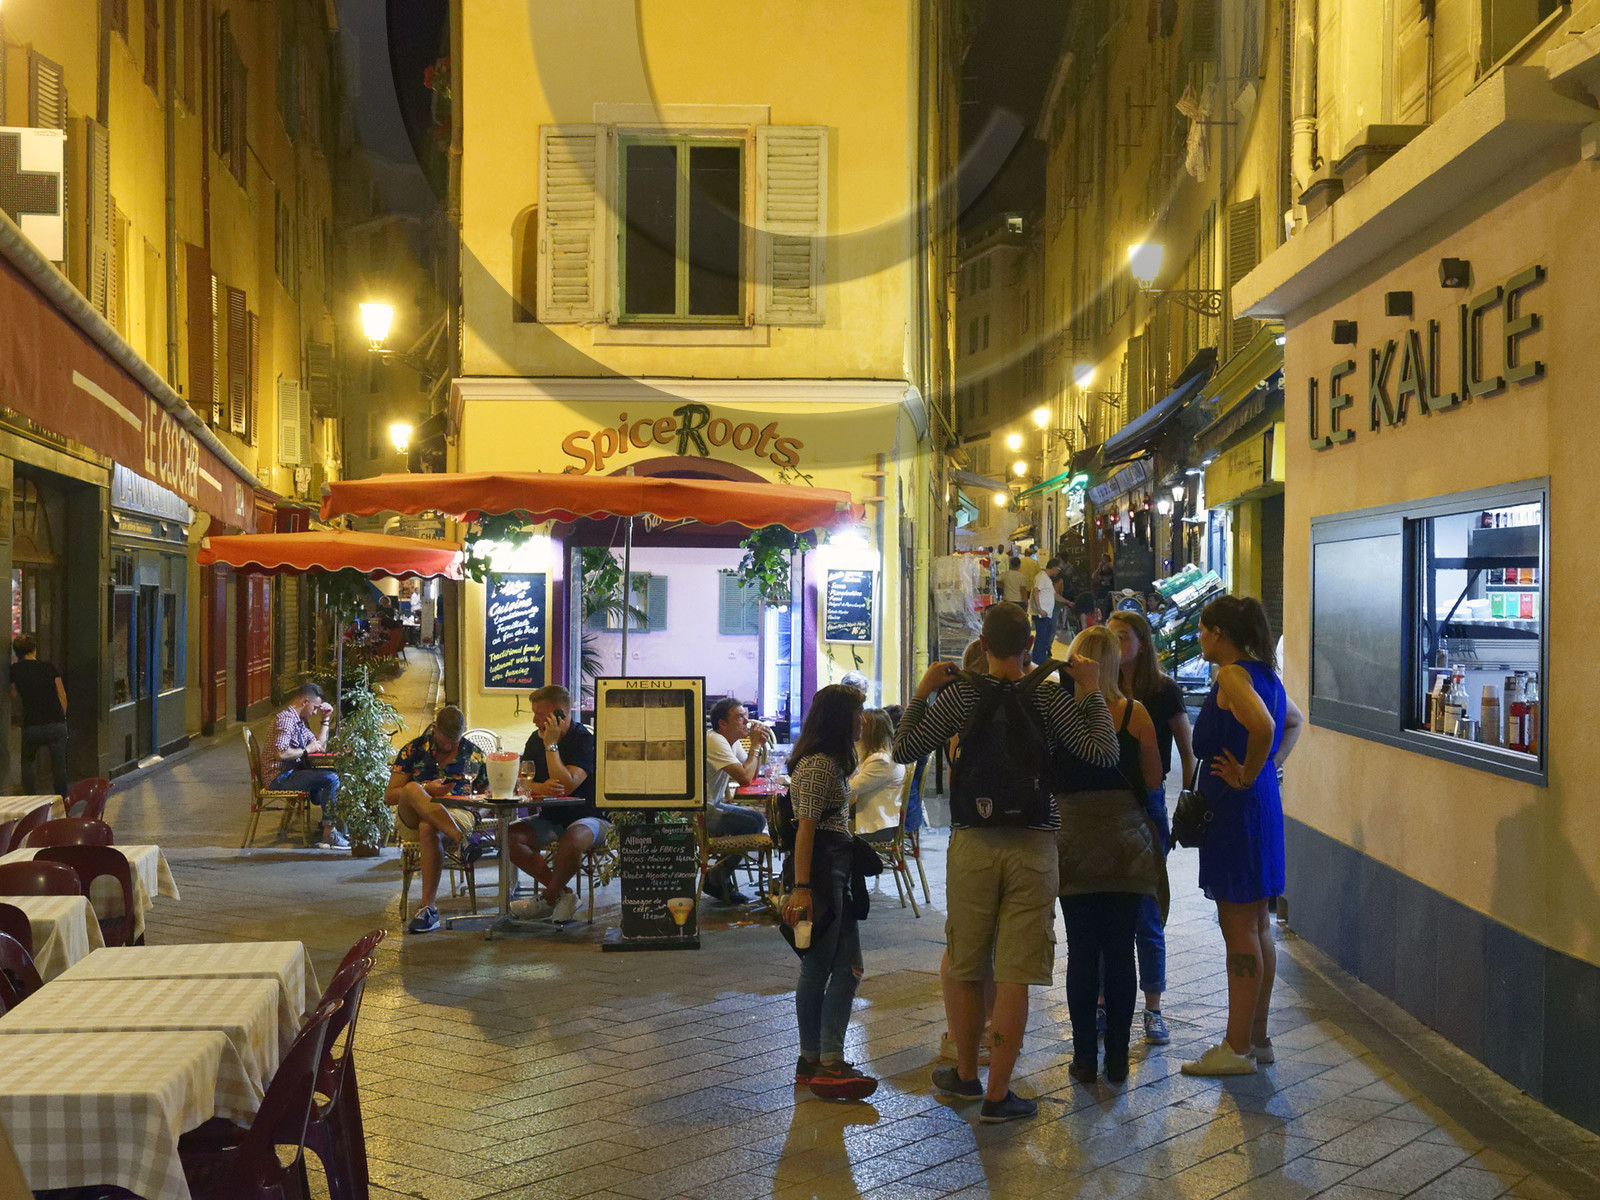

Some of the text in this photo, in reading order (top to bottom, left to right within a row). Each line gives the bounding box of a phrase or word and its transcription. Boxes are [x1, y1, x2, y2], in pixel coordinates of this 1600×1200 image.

[1308, 264, 1547, 450] LE KALICE
[144, 393, 157, 477] LE
[626, 680, 673, 689] MENU
